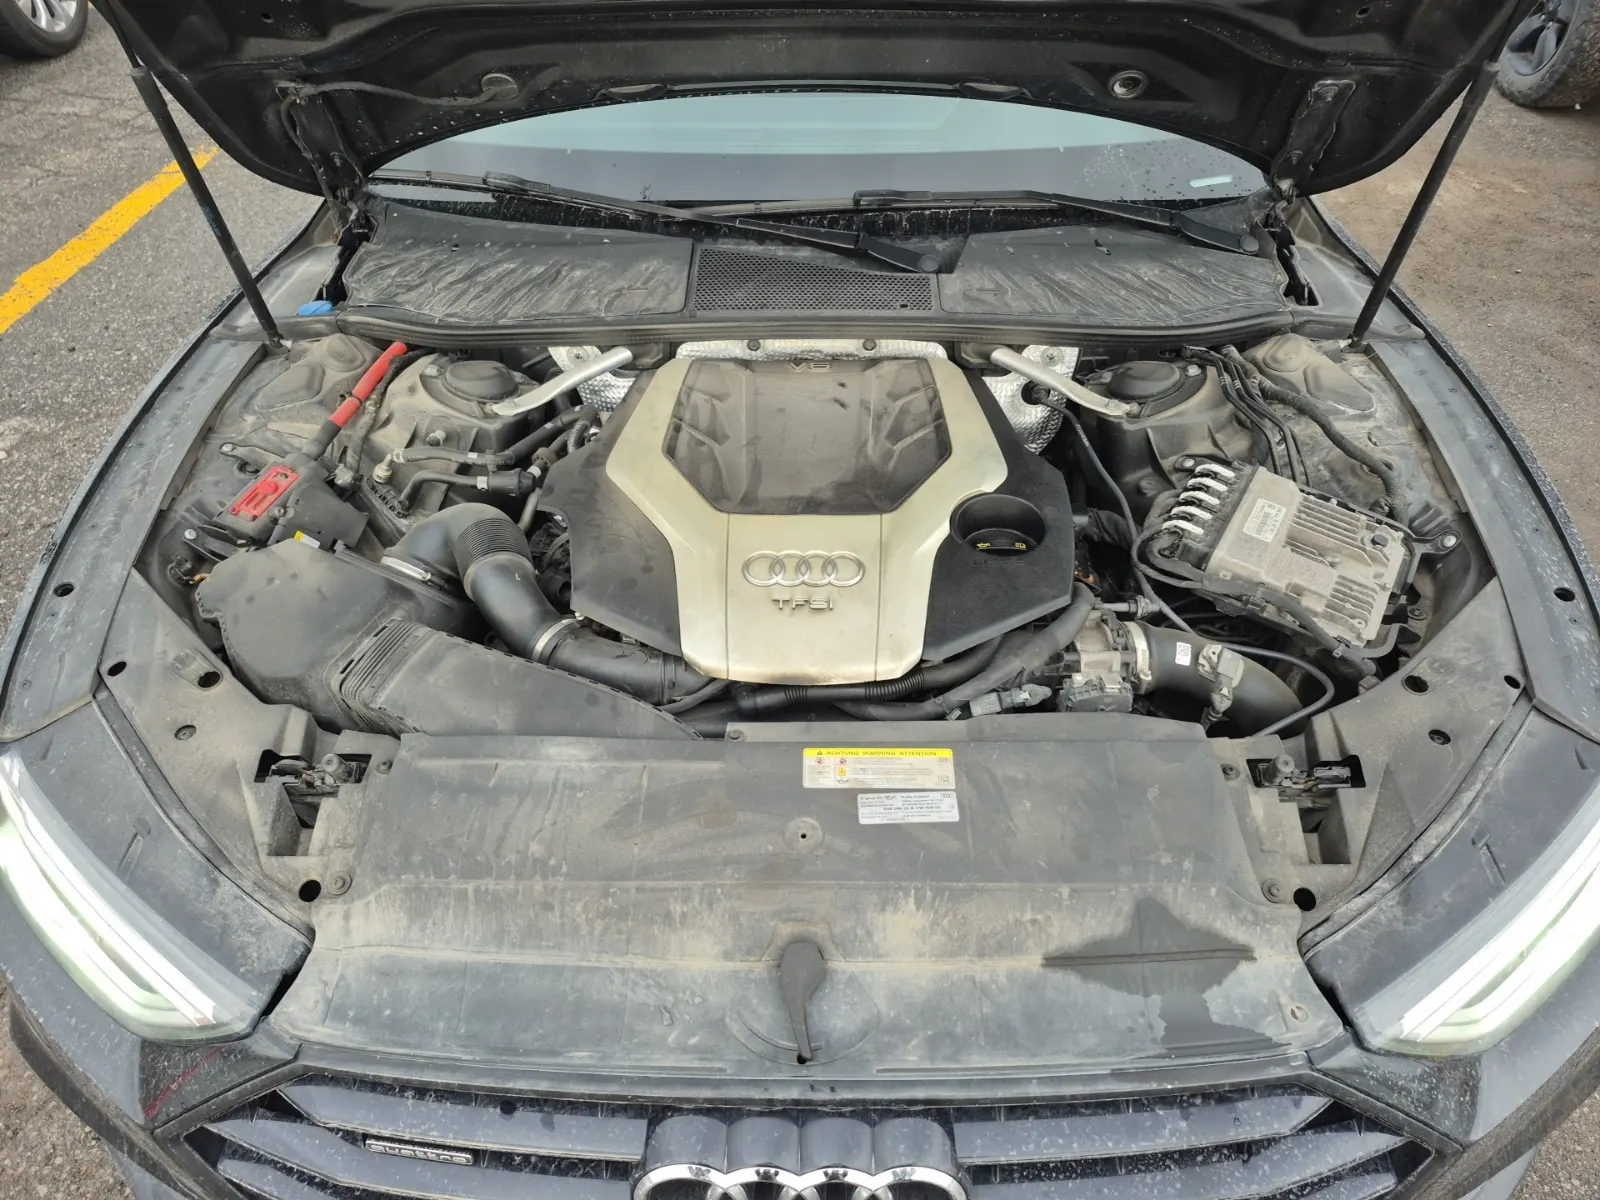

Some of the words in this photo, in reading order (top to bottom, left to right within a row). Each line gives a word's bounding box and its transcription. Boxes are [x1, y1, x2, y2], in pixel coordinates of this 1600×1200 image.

[788, 361, 831, 373] V6
[771, 596, 834, 611] TFSI
[370, 1144, 467, 1163] quattro
